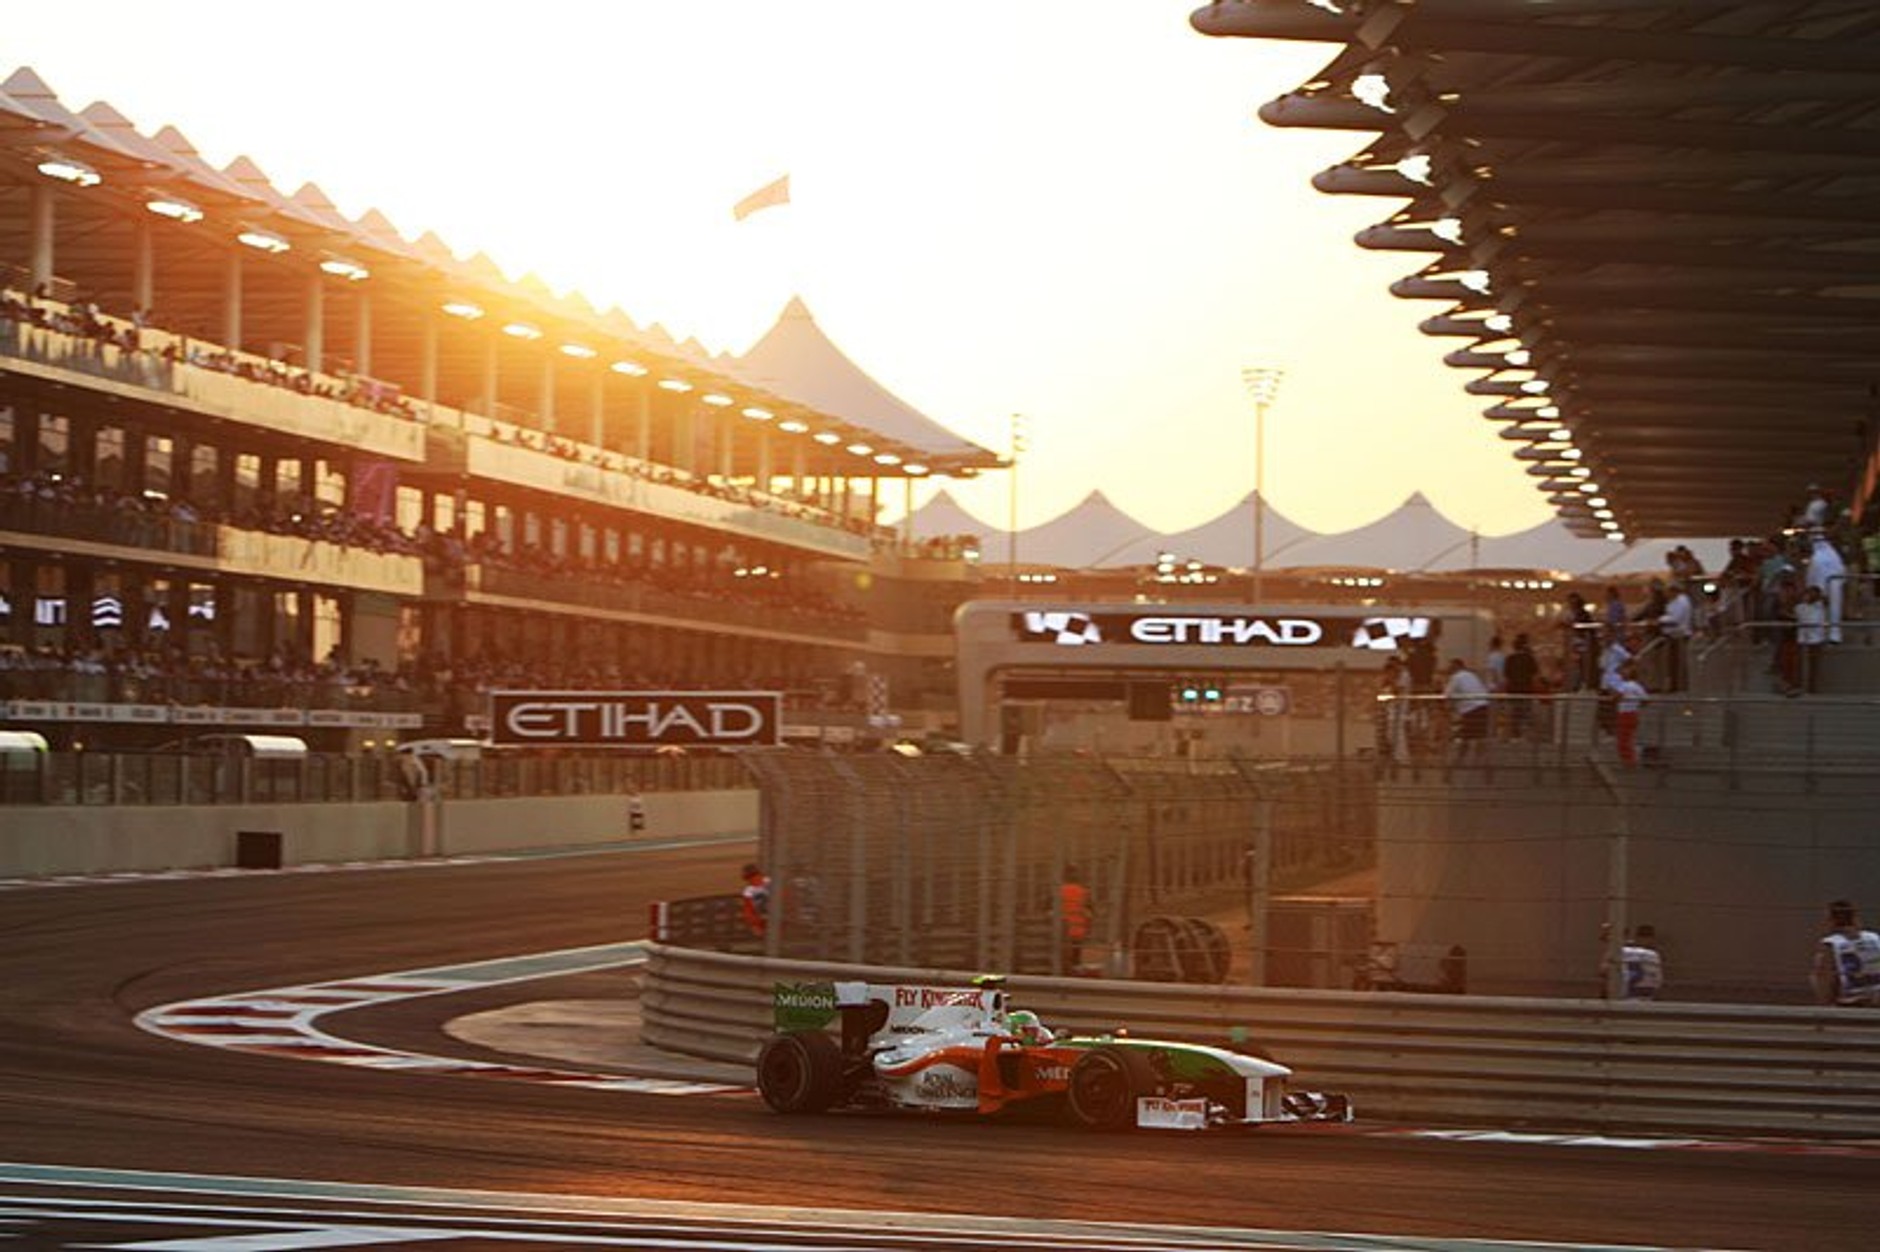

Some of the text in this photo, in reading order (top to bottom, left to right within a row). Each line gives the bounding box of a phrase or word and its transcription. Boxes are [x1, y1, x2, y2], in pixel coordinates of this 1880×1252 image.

[1131, 617, 1322, 645] ETIHAD
[507, 702, 762, 737] ETIHAD
[775, 993, 834, 1009] MEDION
